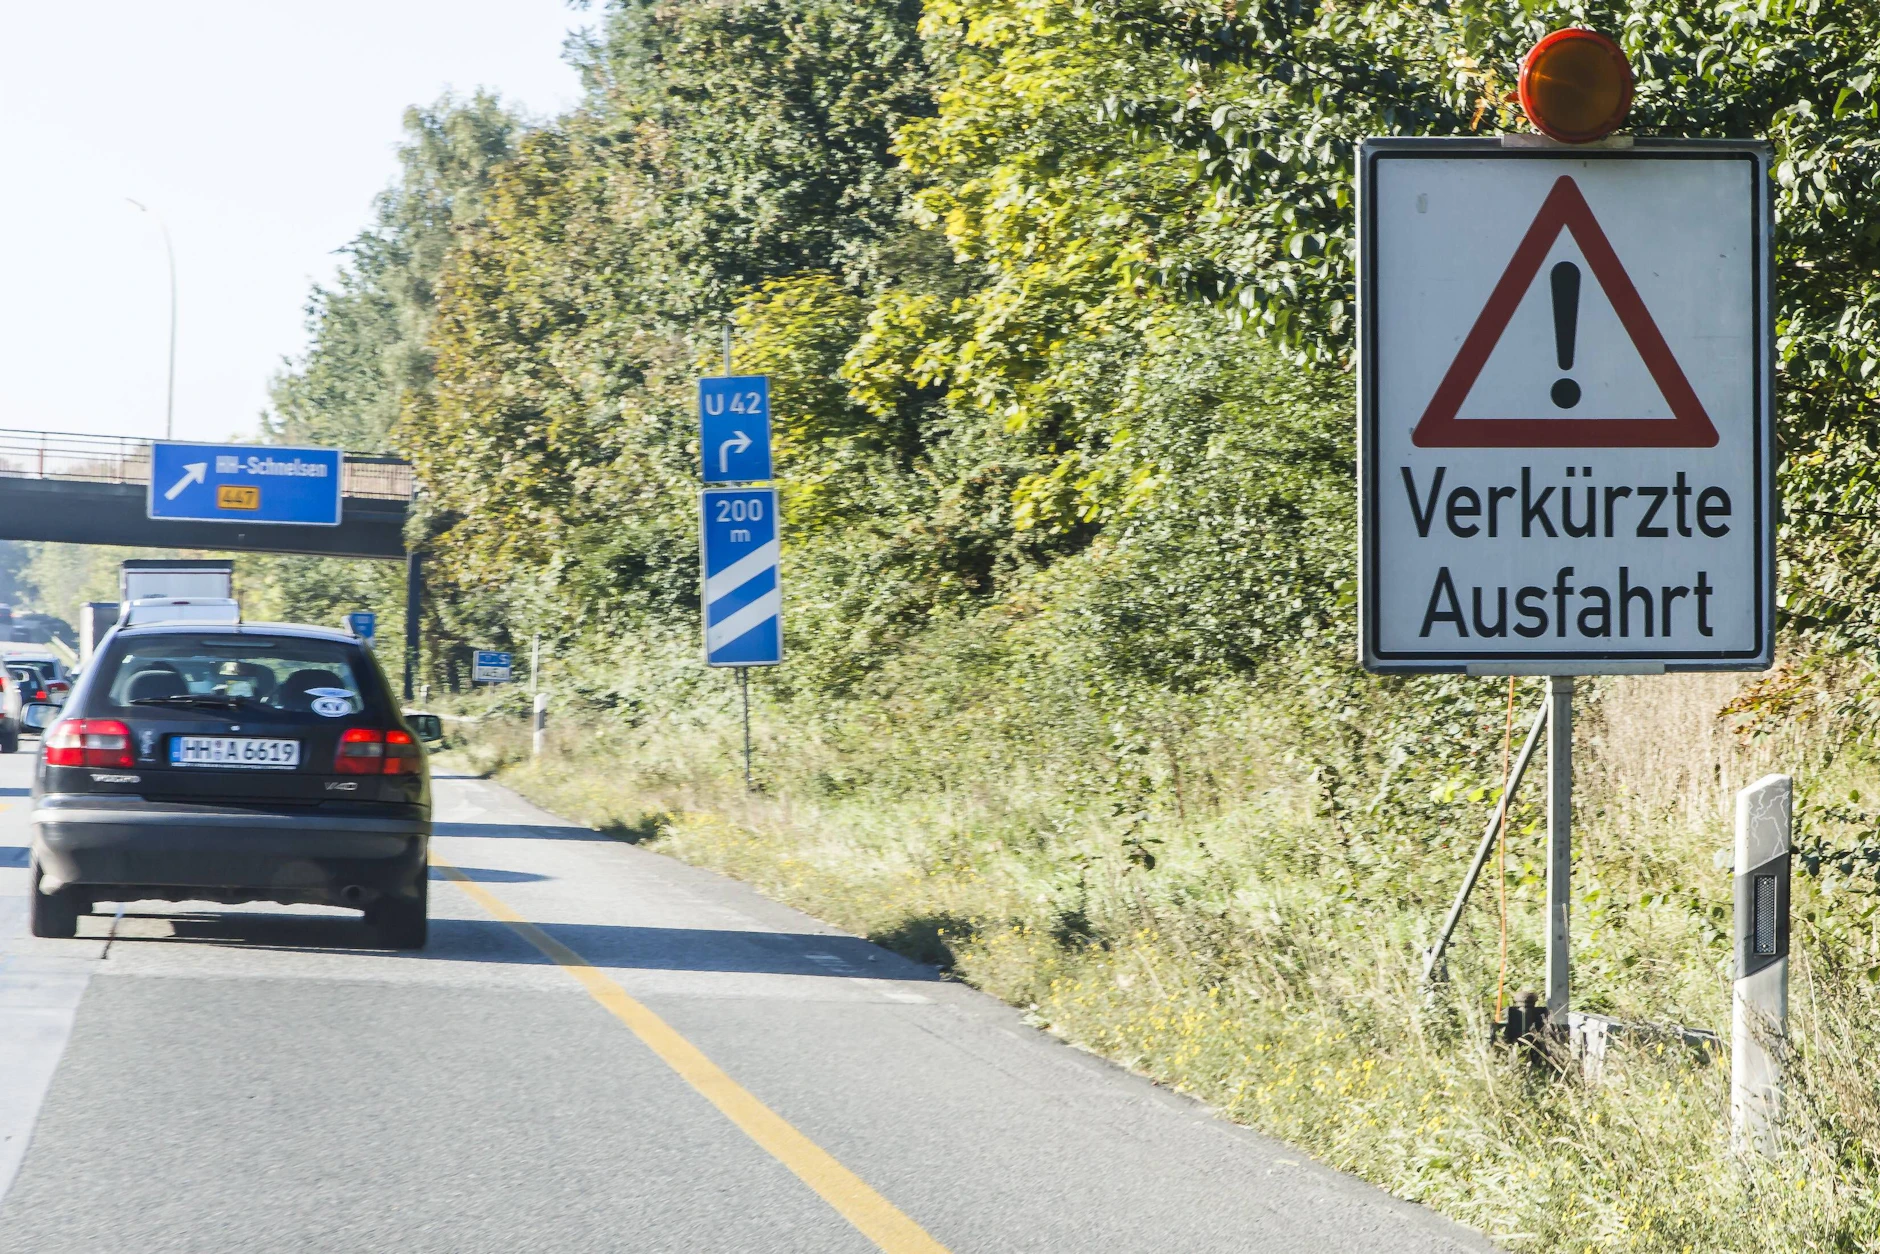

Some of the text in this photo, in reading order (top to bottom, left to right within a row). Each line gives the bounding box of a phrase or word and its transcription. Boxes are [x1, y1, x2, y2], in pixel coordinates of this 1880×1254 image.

[705, 392, 762, 416] U 42
[221, 489, 256, 505] 447
[1400, 466, 1732, 539] Verkürzte
[716, 499, 764, 522] 200
[730, 529, 751, 543] m
[1419, 566, 1714, 638] Ausfahrt
[245, 741, 296, 762] 6619
